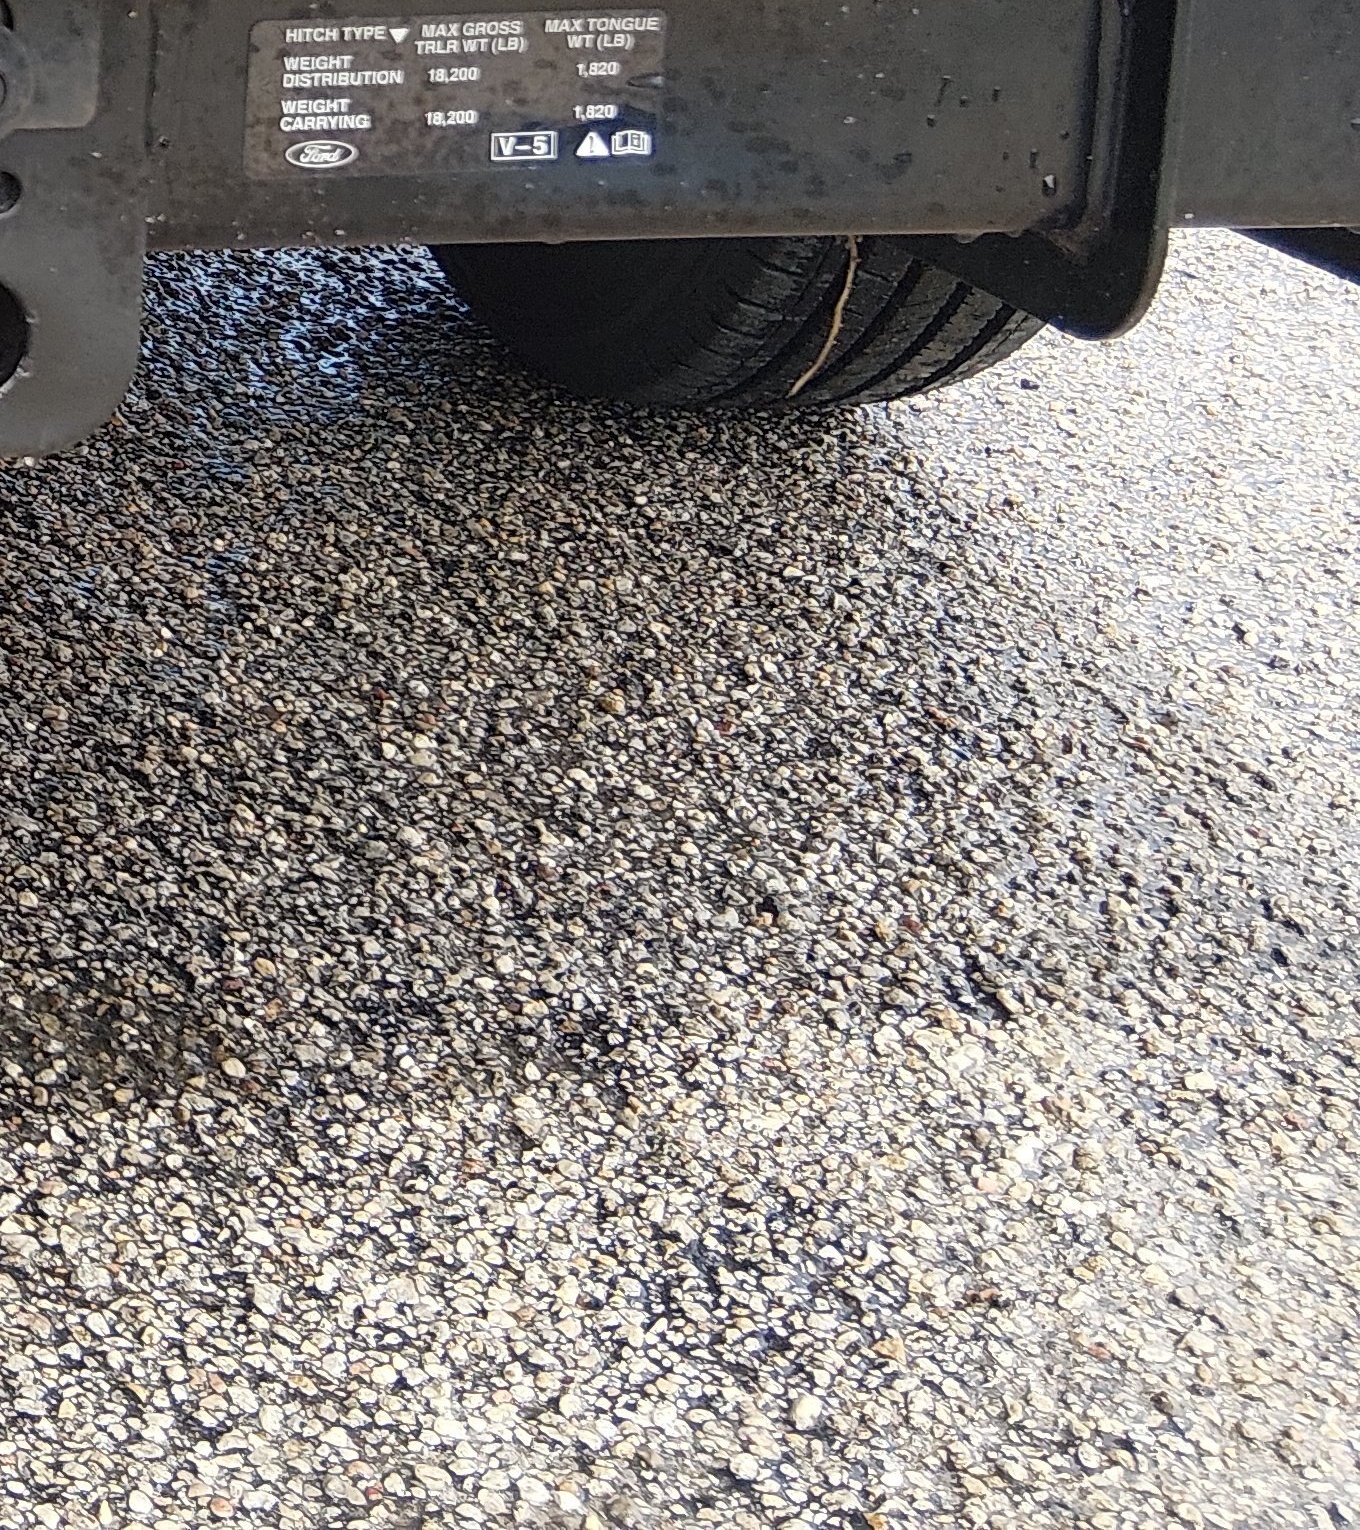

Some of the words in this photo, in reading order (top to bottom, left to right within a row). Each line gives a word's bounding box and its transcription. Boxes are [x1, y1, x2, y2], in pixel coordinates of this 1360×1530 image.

[421, 23, 460, 37] MAX
[462, 21, 522, 36] GROSS
[545, 18, 585, 33] MAX
[588, 17, 661, 31] TONGUE
[285, 27, 339, 43] HITCH
[341, 26, 387, 40] TYPE
[567, 35, 595, 48] WT
[596, 34, 634, 51] (LB)
[415, 40, 460, 54] TRLR
[462, 39, 489, 52] WT
[491, 37, 528, 55] (LB)
[284, 55, 353, 71] WEIGHT
[576, 61, 620, 78] 1,820
[283, 70, 404, 88] DISTRIBUTION
[427, 67, 479, 84] 18,200
[281, 98, 350, 114] WEIGHT
[573, 104, 618, 121] 1,820
[280, 114, 372, 131] CARRYING
[425, 110, 478, 127] 18,200
[300, 144, 342, 163] Ford
